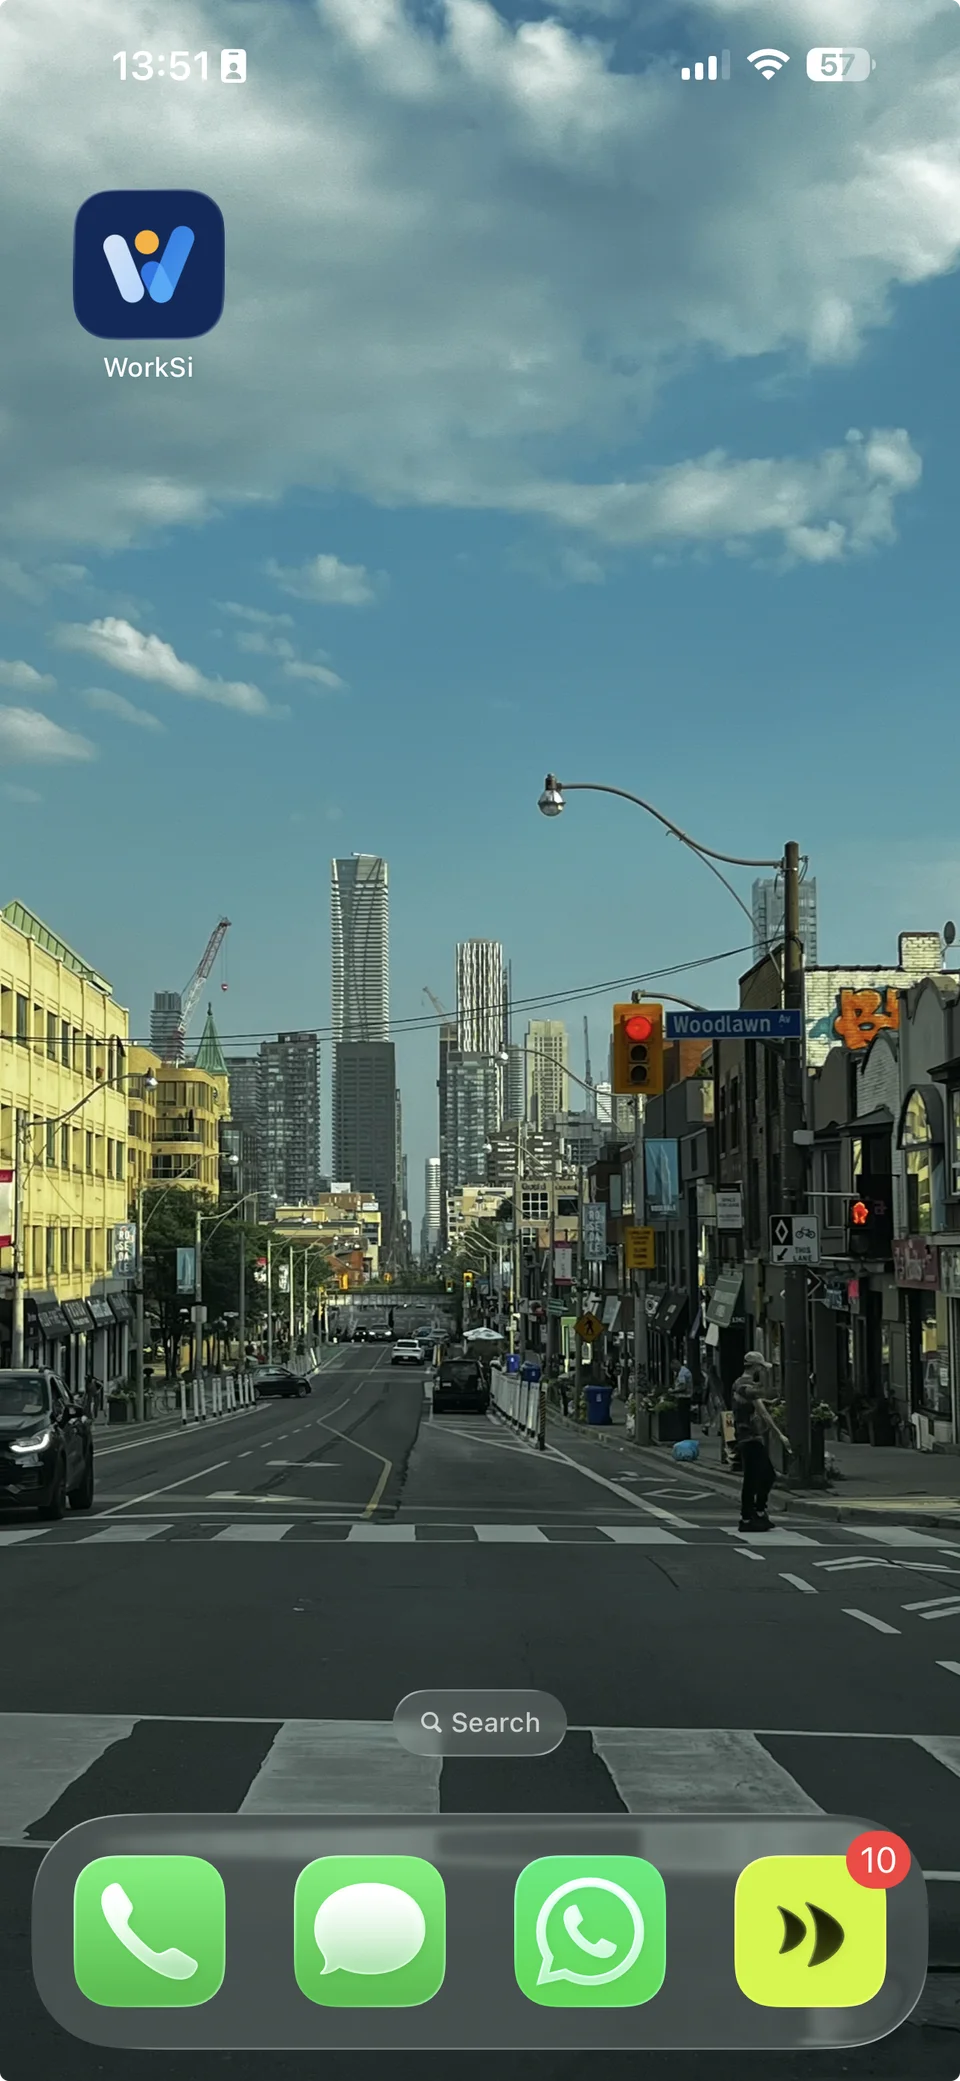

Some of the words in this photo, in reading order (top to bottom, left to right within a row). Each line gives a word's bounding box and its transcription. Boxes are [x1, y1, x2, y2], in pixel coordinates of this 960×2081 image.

[112, 50, 208, 81] 13:51
[820, 53, 856, 77] 57
[103, 356, 193, 378] WorkSi
[673, 1015, 771, 1034] Woodlawn
[778, 1014, 791, 1025] Av
[793, 1255, 813, 1263] LANE
[794, 1246, 811, 1254] THIS
[451, 1711, 540, 1733] Search
[860, 1847, 897, 1875] 10
